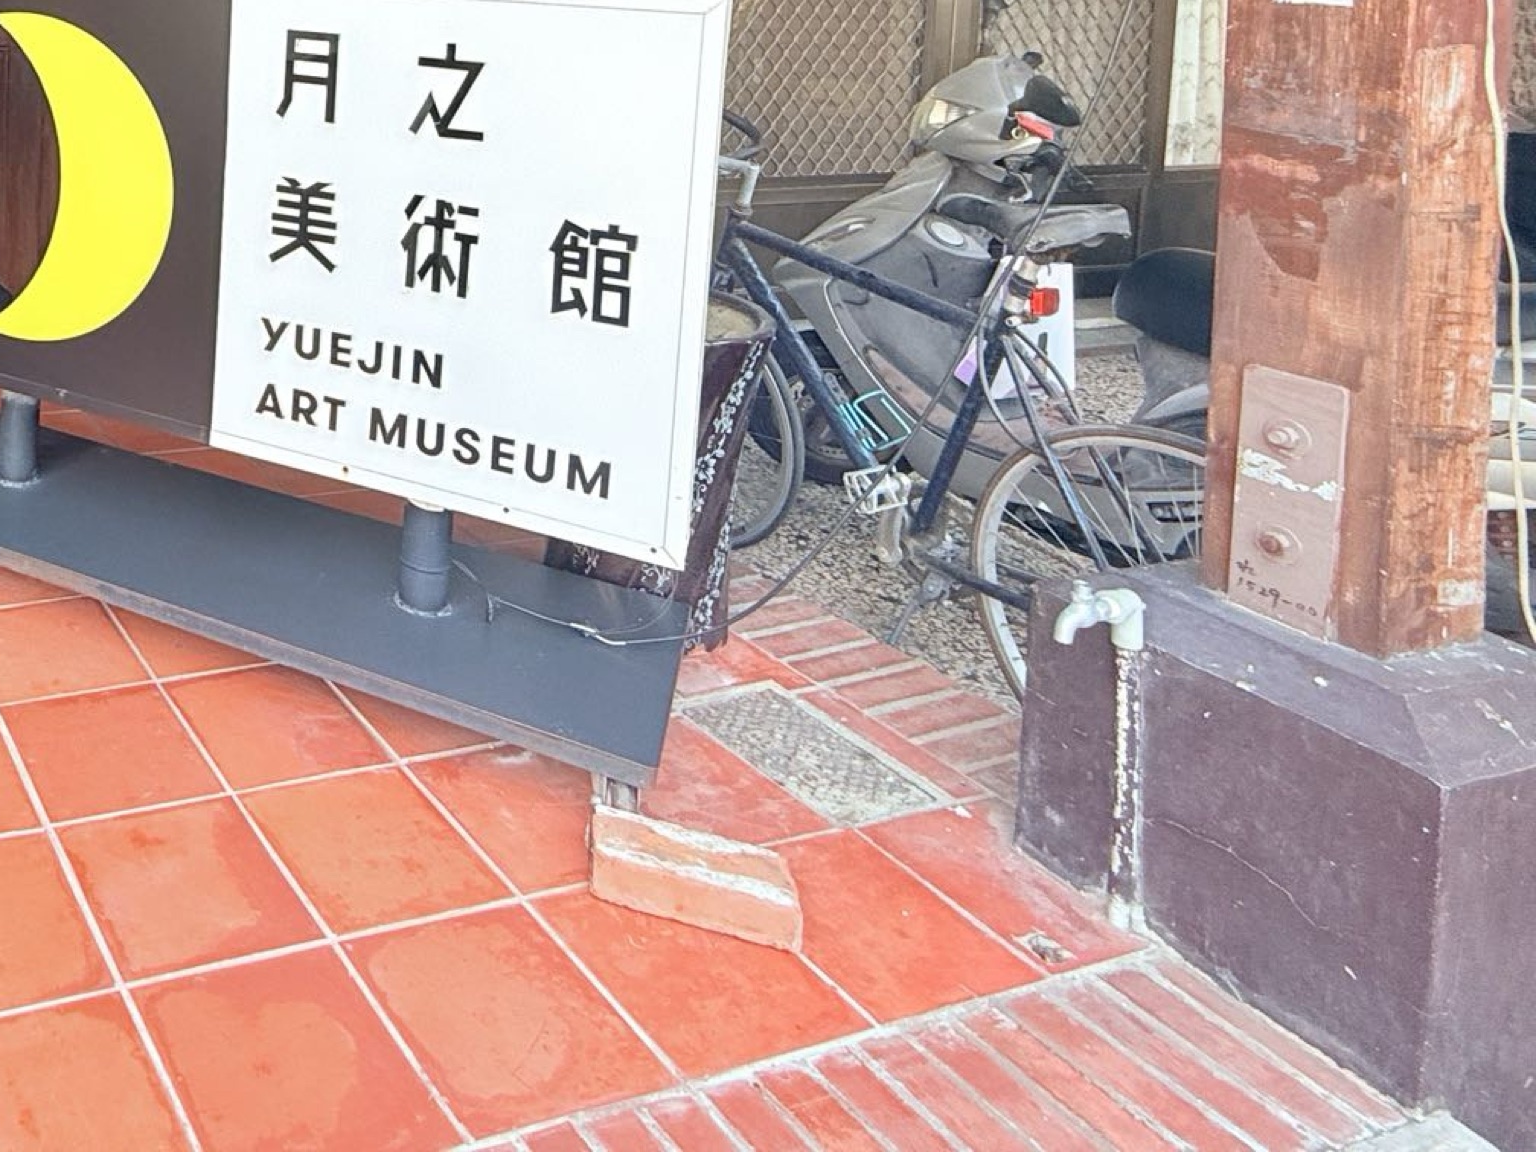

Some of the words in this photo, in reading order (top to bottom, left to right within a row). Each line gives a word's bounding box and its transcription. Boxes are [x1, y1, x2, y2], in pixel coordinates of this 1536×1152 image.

[276, 28, 486, 142] 月之
[268, 175, 638, 328] 美術館
[261, 316, 445, 390] YUEJIN
[254, 383, 346, 433] ART
[368, 406, 612, 501] MUSEUM
